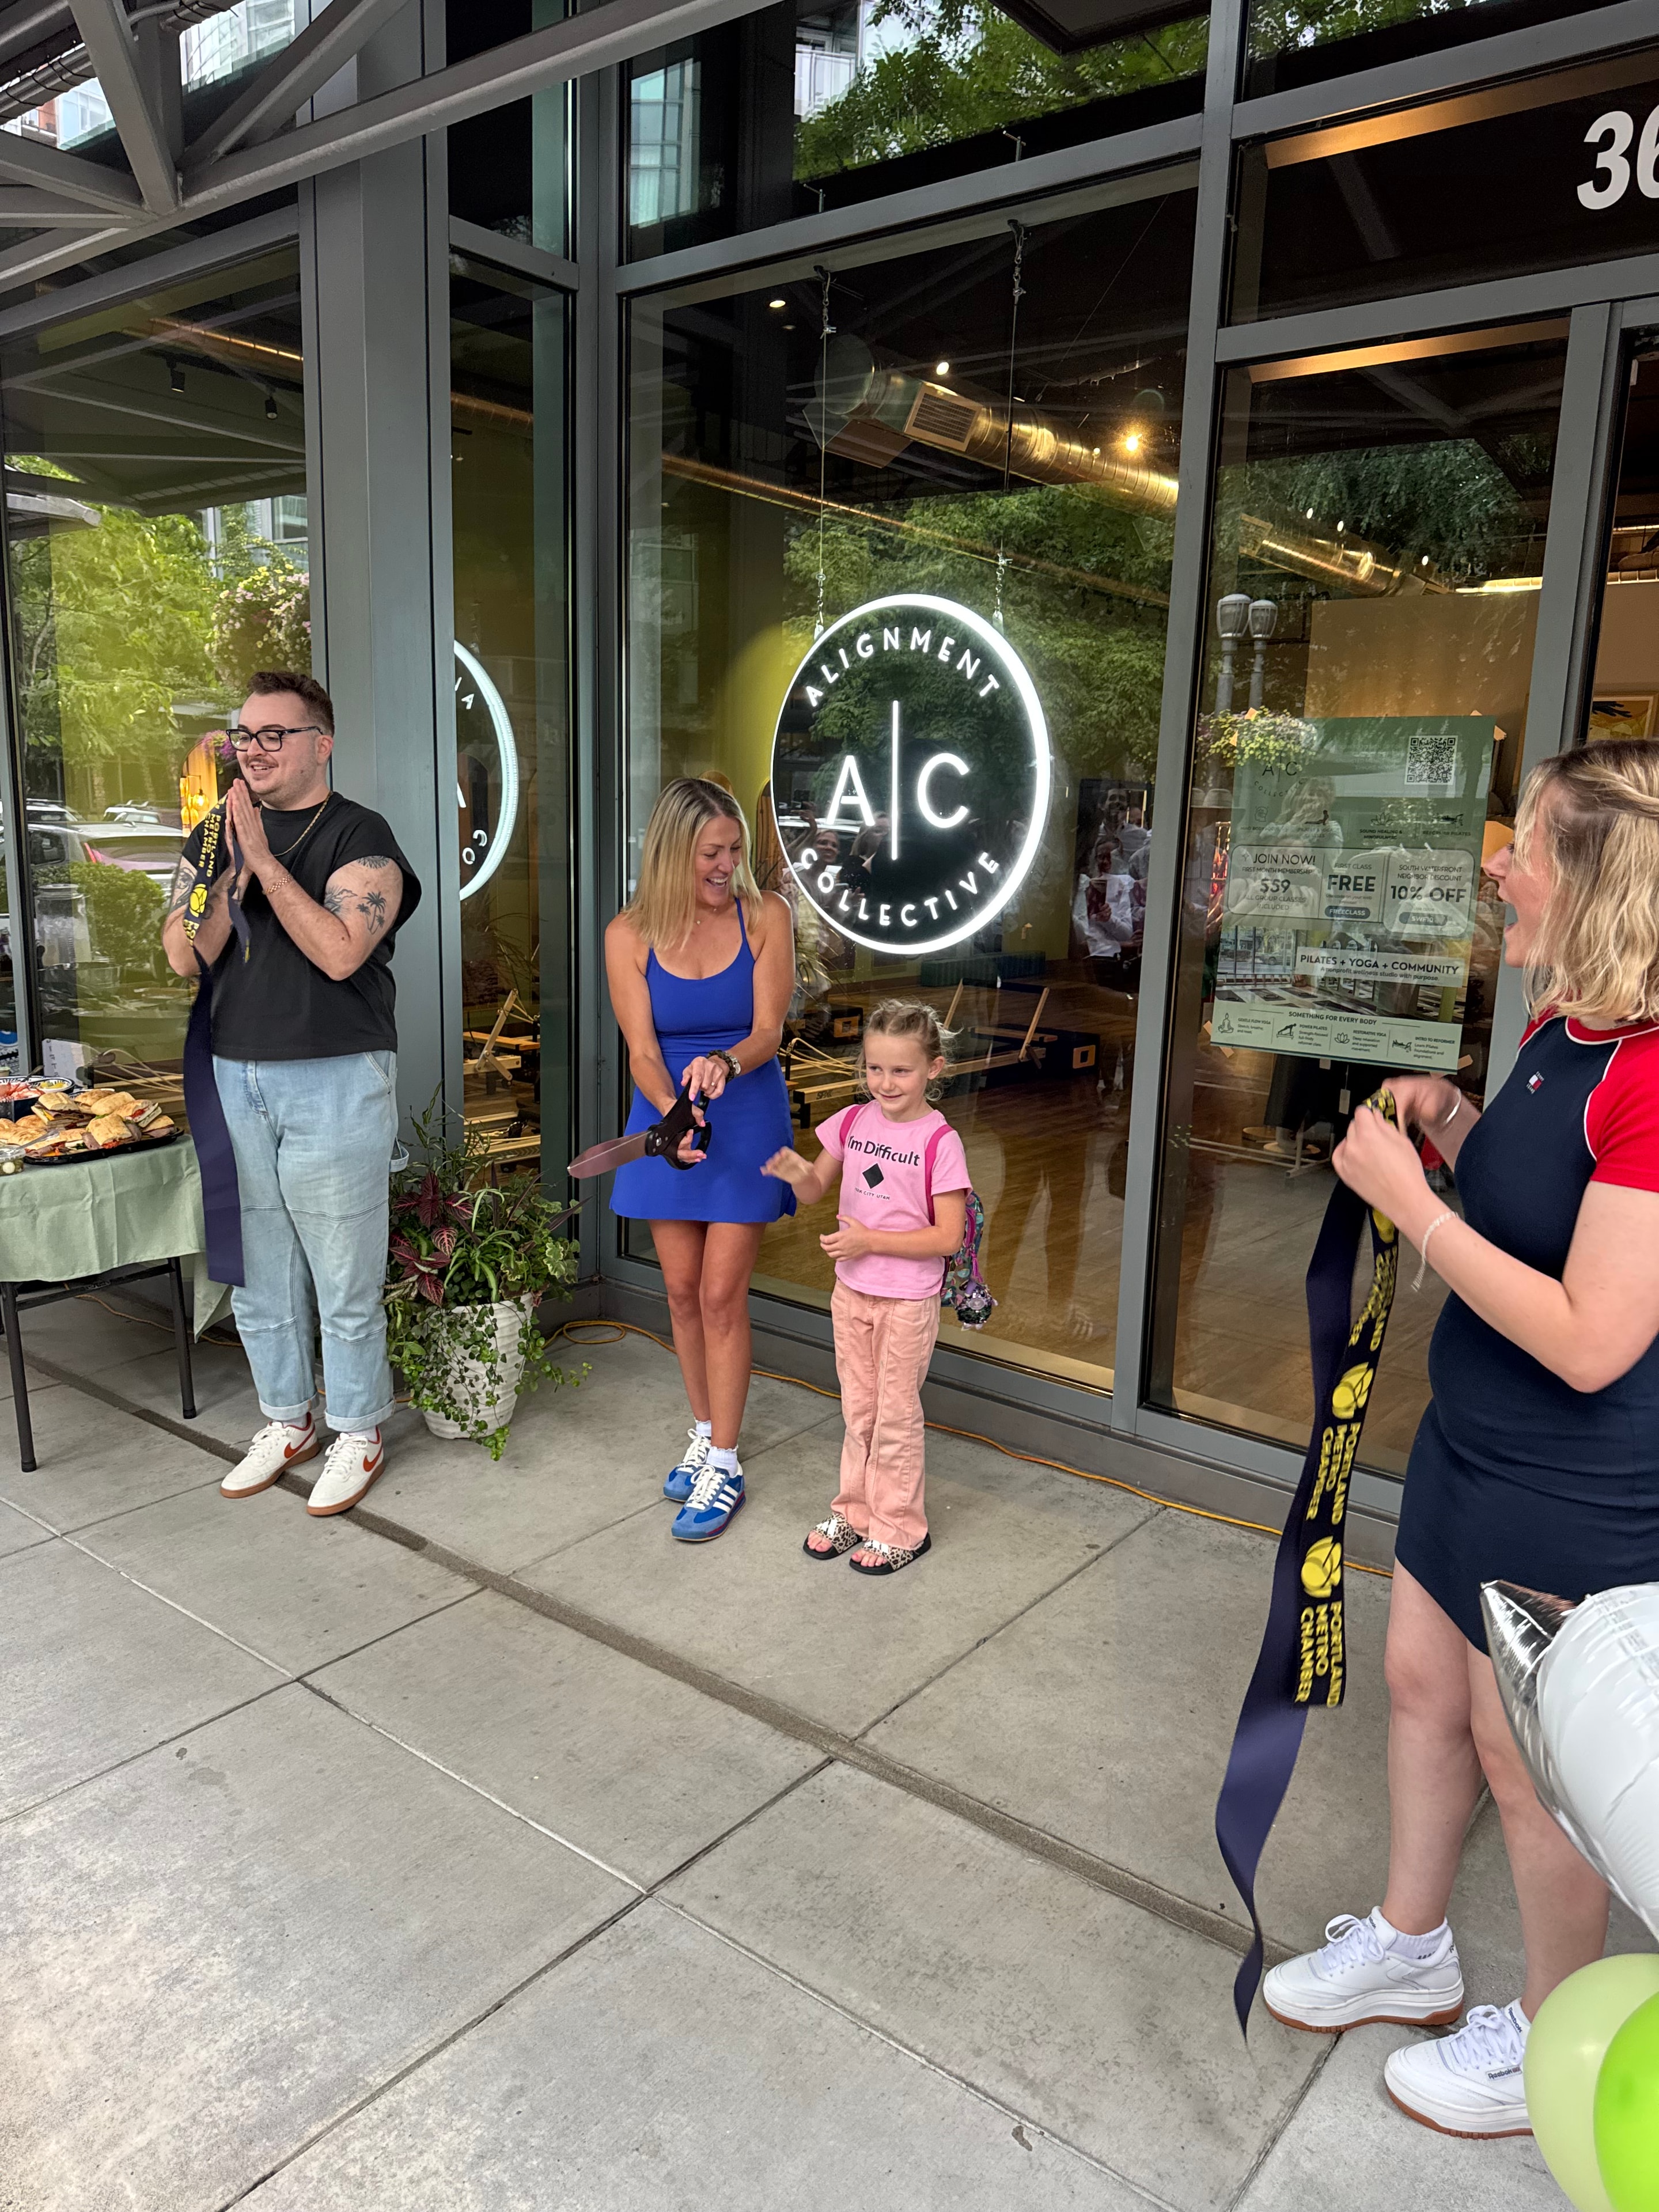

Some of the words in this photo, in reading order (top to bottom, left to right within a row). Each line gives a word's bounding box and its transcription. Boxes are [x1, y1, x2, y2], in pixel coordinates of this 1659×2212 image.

[806, 626, 999, 707] ALIGNMENT
[825, 755, 876, 827] A
[916, 752, 970, 829] C
[198, 812, 211, 868] CHAMBER
[206, 815, 221, 877] PORTLAND
[207, 813, 216, 853] METRO
[1253, 853, 1278, 864] JOIN
[1282, 854, 1316, 865] NOW!
[800, 847, 1000, 927] COLLECTIVE
[1260, 877, 1291, 893] $59
[1327, 874, 1376, 892] FREE
[1391, 885, 1422, 900] 10%
[1429, 887, 1467, 903] OFF
[1300, 955, 1337, 965] PILATES
[1349, 958, 1379, 968] YOGA
[1391, 961, 1459, 975] COMMUNITY
[1289, 1011, 1324, 1020] SOMETHING
[1359, 1017, 1377, 1025] BODY
[848, 1135, 862, 1151] I'm
[863, 1141, 920, 1166] Difficult
[1306, 1426, 1334, 1521] CHAMBER
[1325, 1424, 1347, 1492] METRO
[1332, 1422, 1361, 1525] PORTLAND
[1294, 1607, 1315, 1703] CHAMBER
[1316, 1603, 1329, 1676] METRO
[1327, 1600, 1343, 1708] PORTLAND
[1508, 2006, 1522, 2033] Reebok
[1487, 2068, 1513, 2080] Reebok
